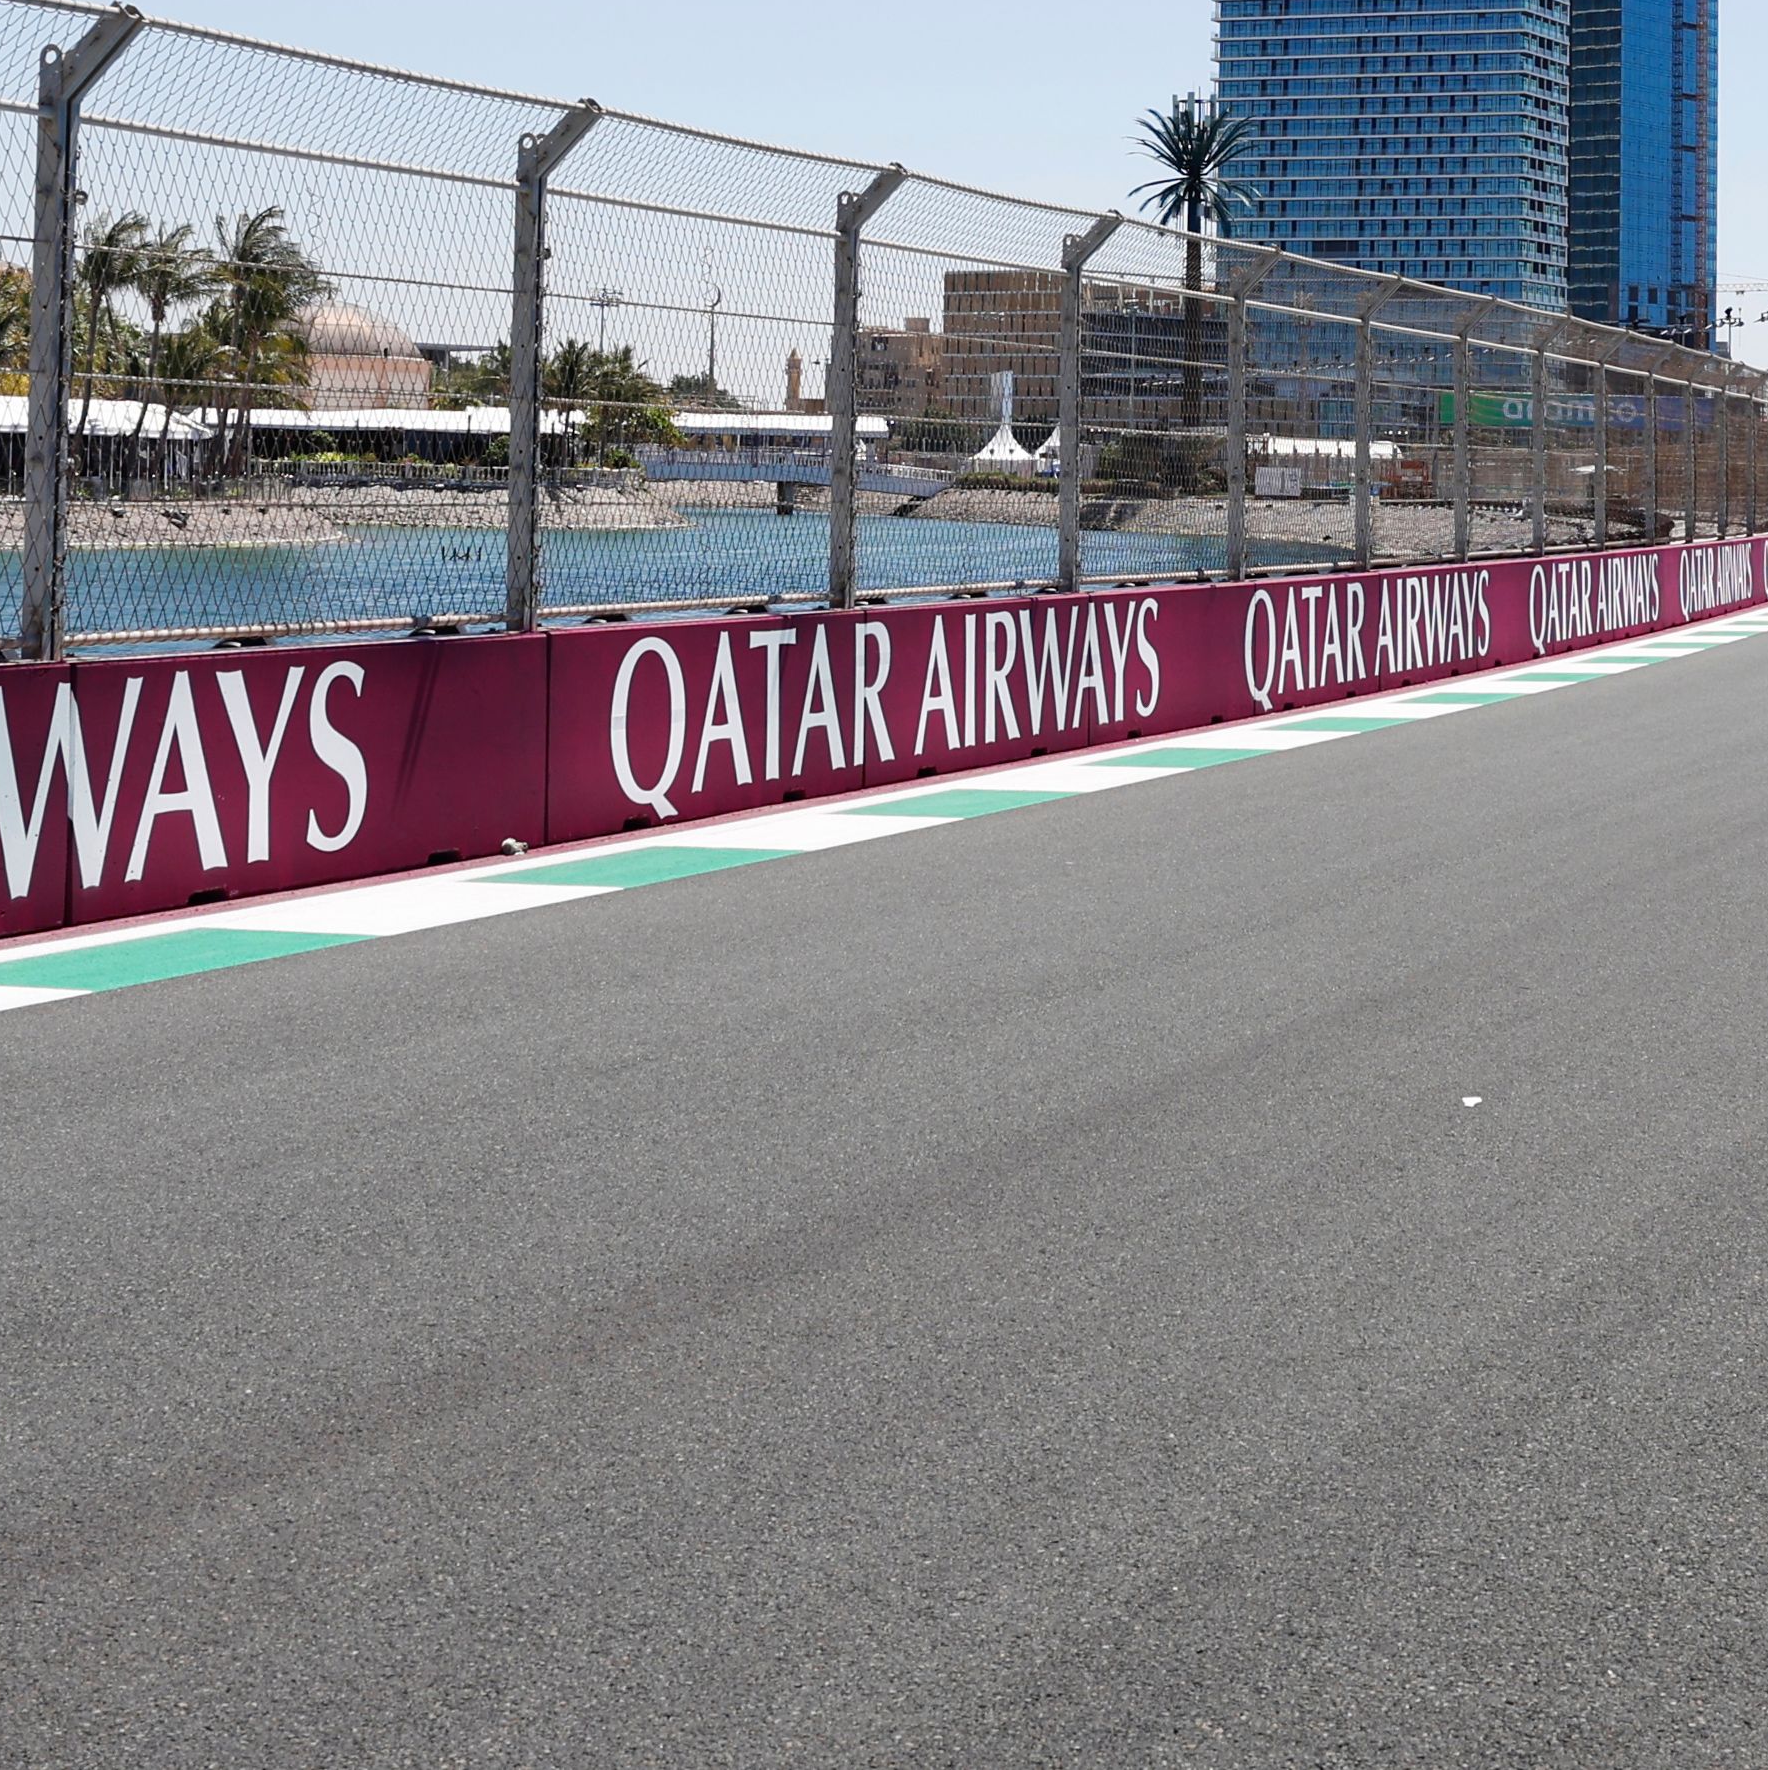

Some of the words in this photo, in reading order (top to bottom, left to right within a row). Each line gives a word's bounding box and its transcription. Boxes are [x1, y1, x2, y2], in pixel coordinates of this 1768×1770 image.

[1243, 581, 1367, 711] QATAR
[1373, 568, 1493, 676] AIRWAYS
[1529, 558, 1592, 655] QATAR
[1596, 553, 1660, 636] AIRWAYS
[1680, 547, 1715, 621] QATAR
[1716, 542, 1752, 610] AIRWAYS
[610, 621, 895, 820] QATAR
[914, 597, 1161, 757] AIRWAYS
